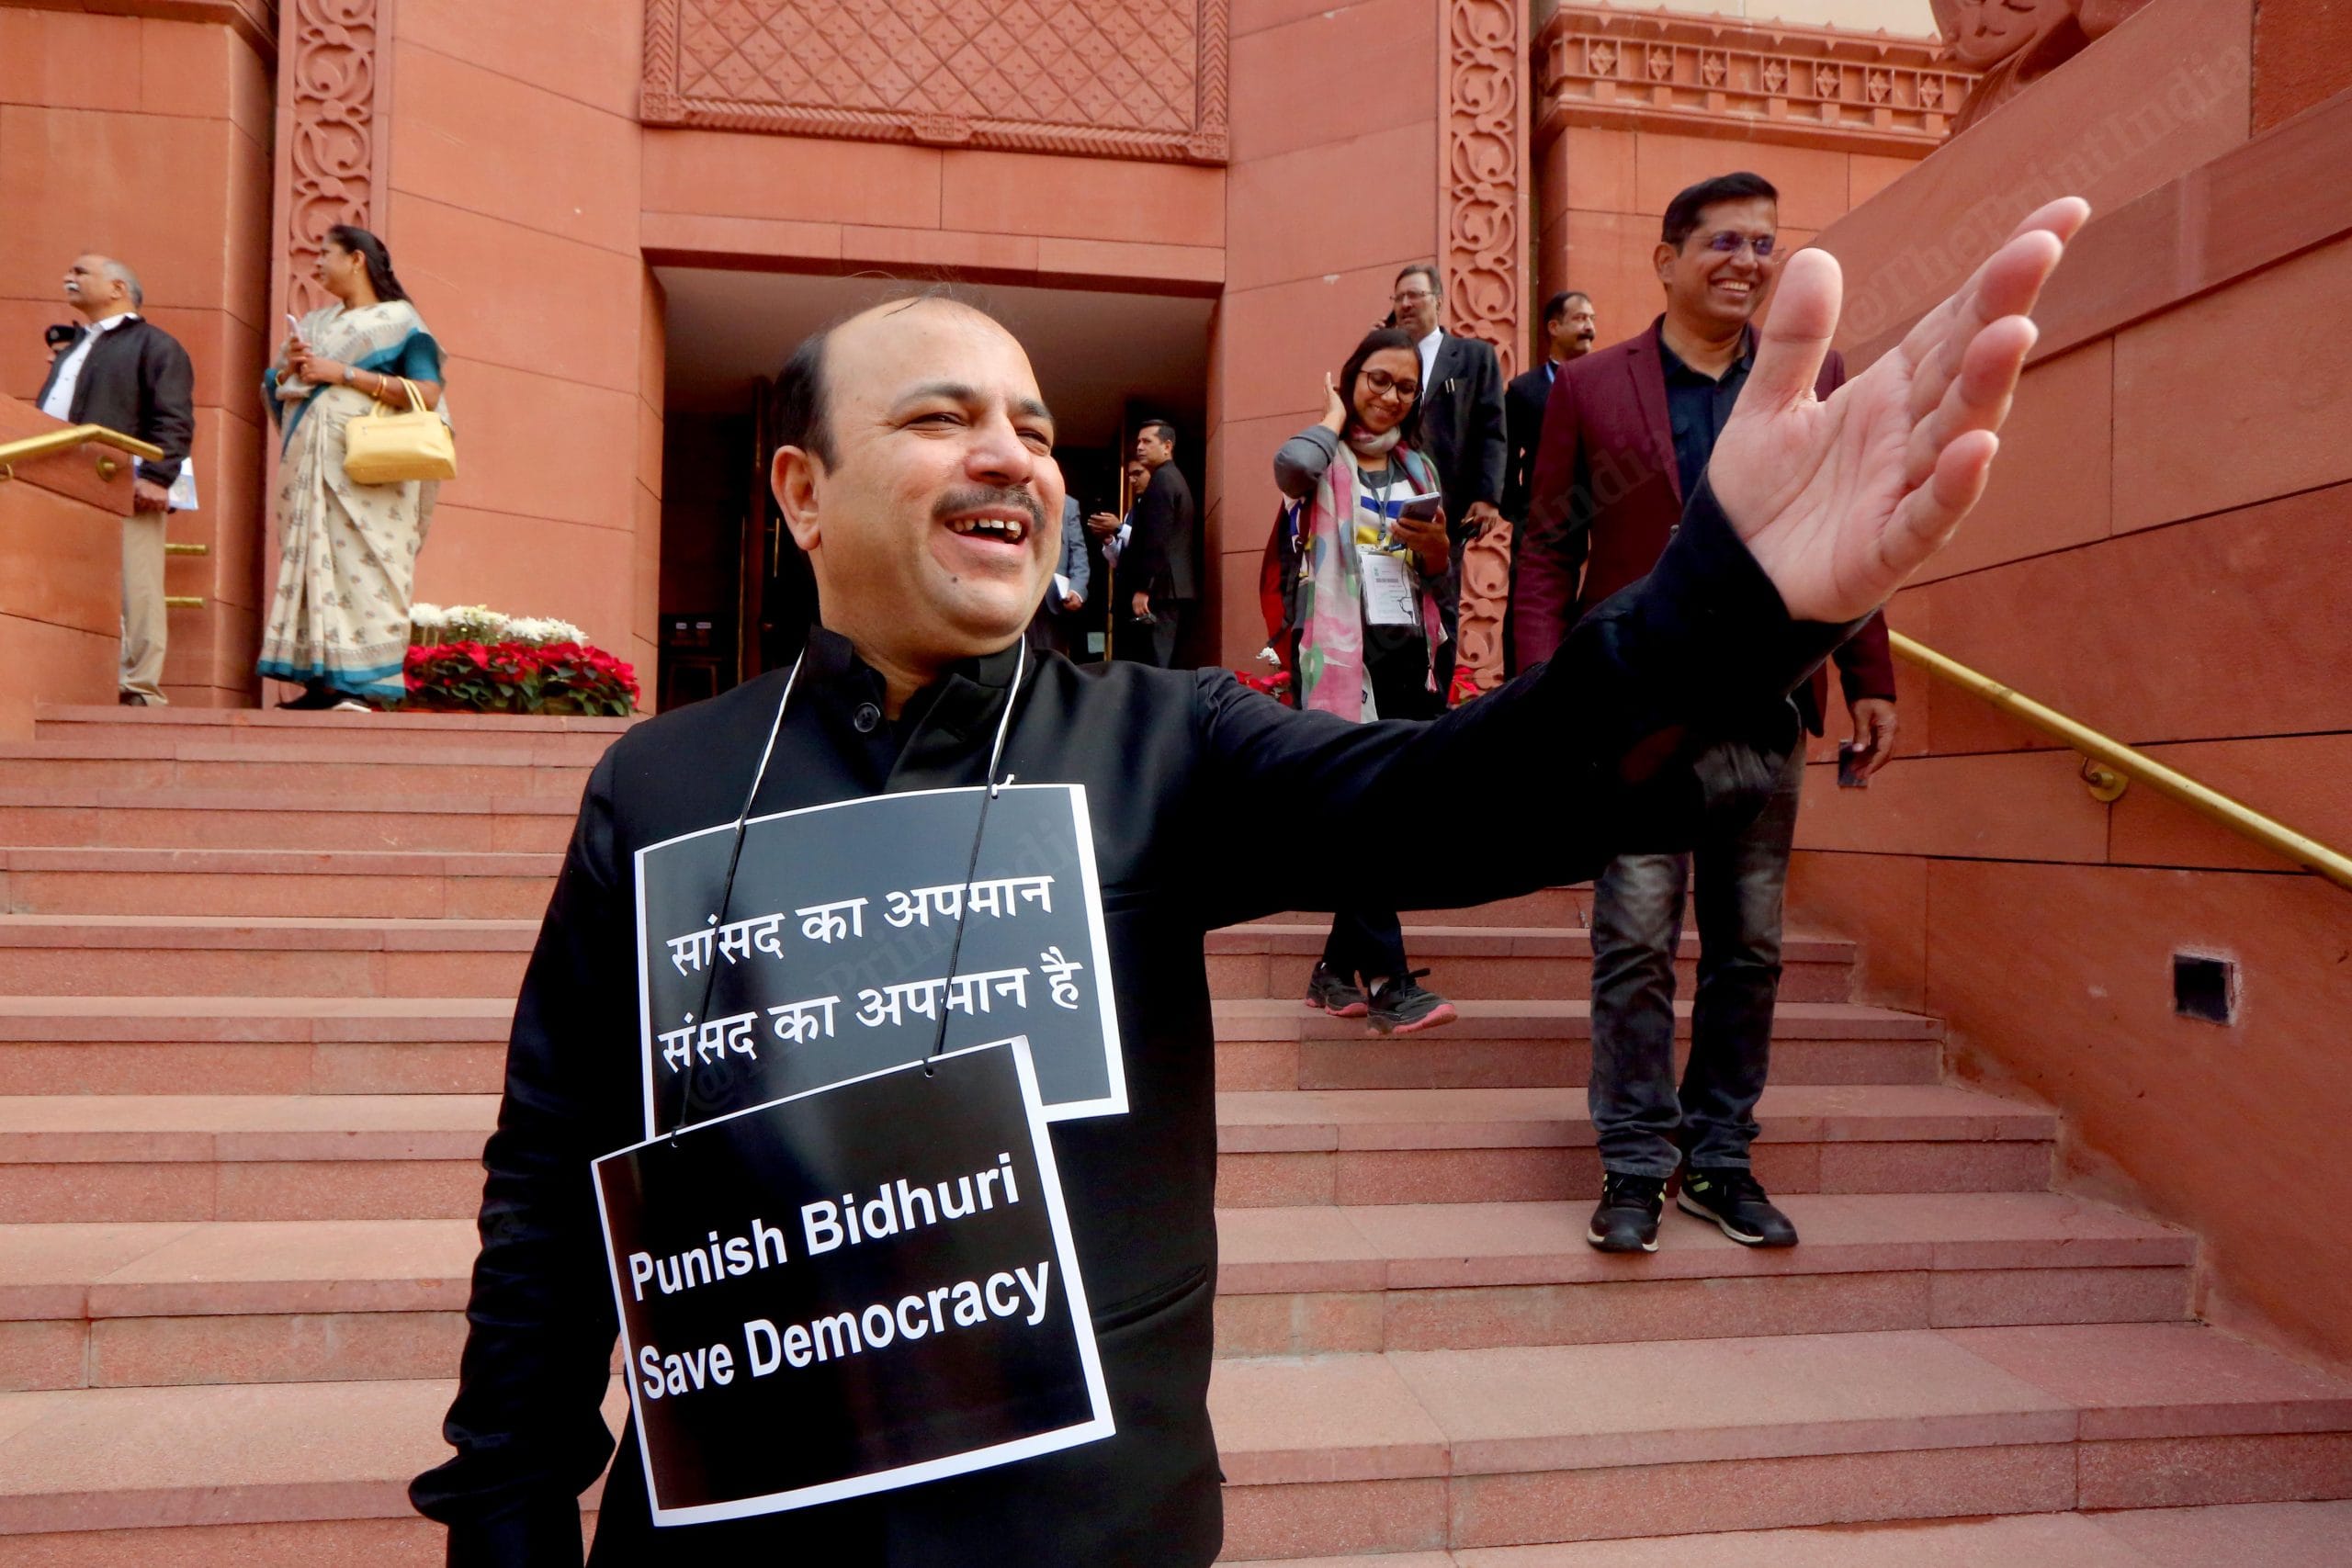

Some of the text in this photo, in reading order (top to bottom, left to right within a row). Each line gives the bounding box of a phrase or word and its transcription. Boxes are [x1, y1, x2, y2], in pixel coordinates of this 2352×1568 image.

[665, 874, 1056, 977] सांसद का अपमान
[657, 945, 1084, 1073] संसद का अपमान है
[628, 1152, 1019, 1302] Punish Bidhuri
[639, 1260, 1049, 1399] Save Democracy
